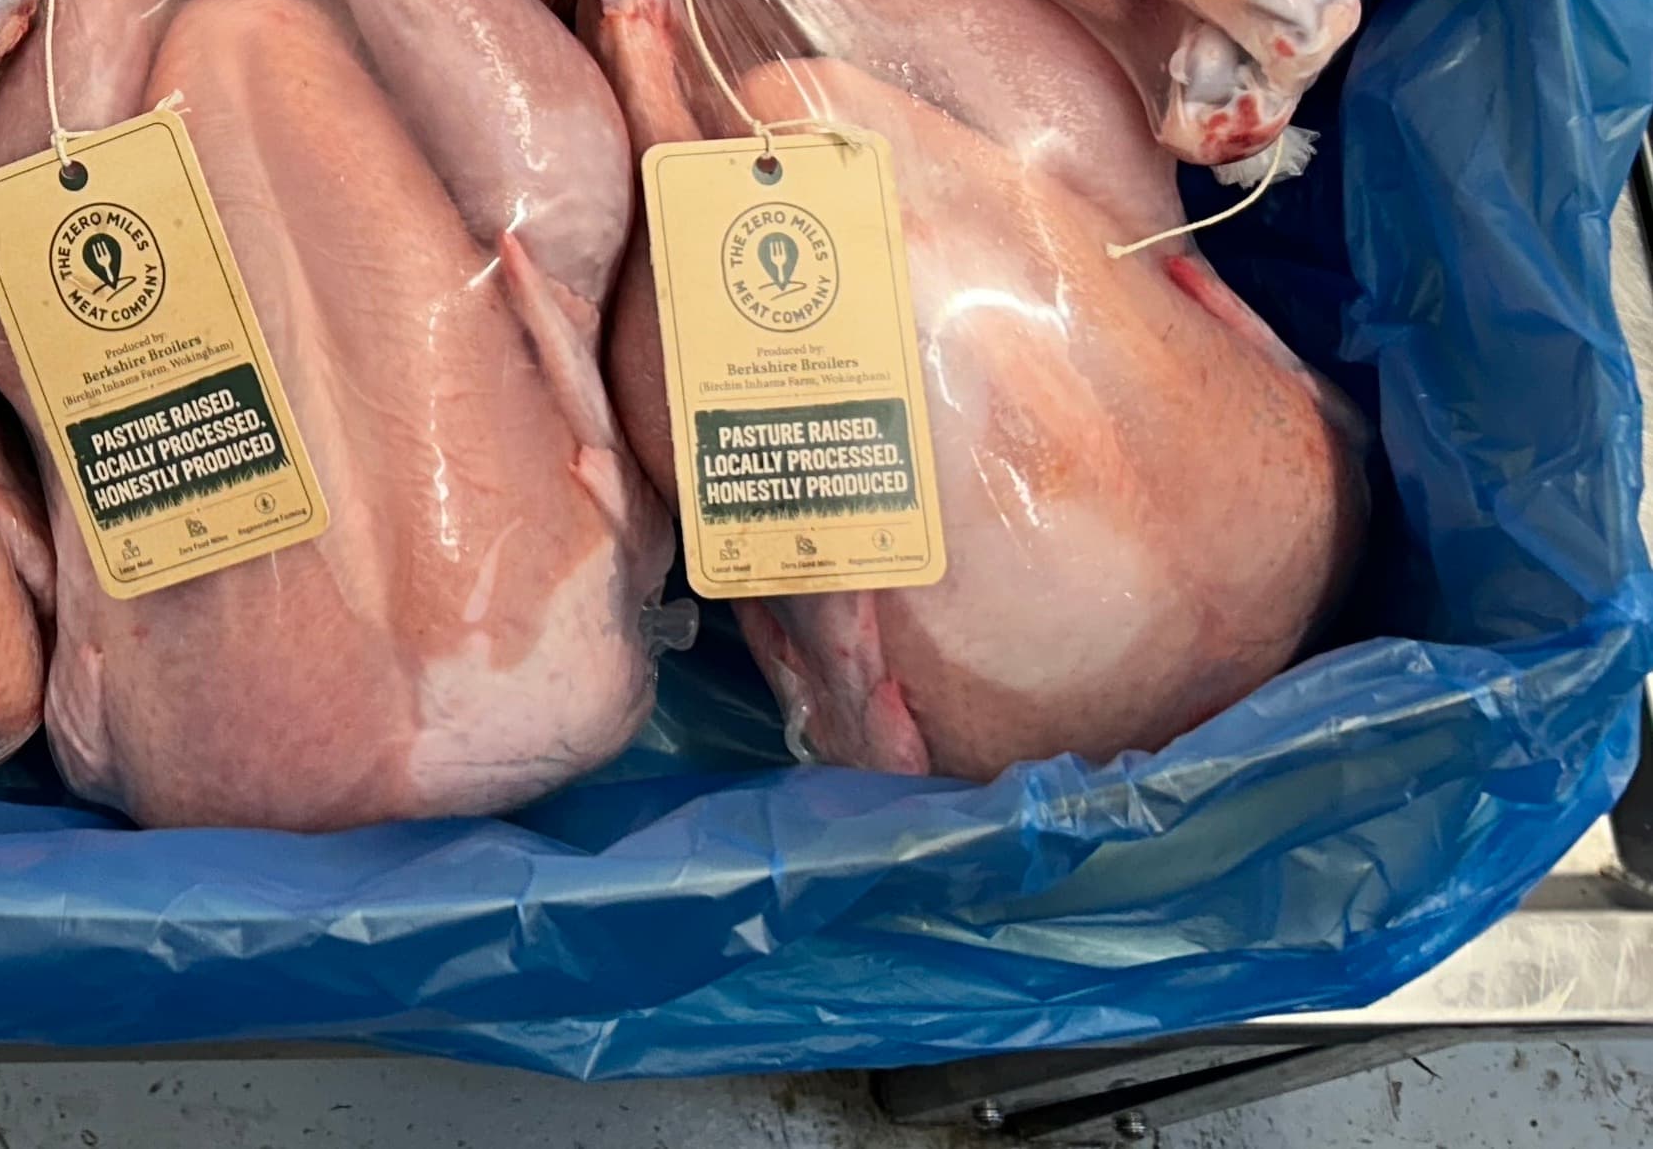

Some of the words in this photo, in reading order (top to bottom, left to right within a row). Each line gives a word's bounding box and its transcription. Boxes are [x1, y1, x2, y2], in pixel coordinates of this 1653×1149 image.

[62, 211, 102, 245] ZERO
[106, 211, 149, 252] MILES
[729, 234, 747, 269] THE
[740, 210, 787, 236] ZERO
[790, 215, 829, 262] MILES
[58, 246, 73, 281] THE
[68, 289, 109, 322] MEAT
[111, 263, 158, 323] COMPANY
[732, 279, 771, 319] MEAT
[771, 275, 832, 324] COMPANY
[81, 356, 147, 386] Berkshire
[147, 335, 203, 362] Broilers
[104, 335, 152, 360] Produced
[725, 360, 798, 377] Berkshire
[800, 355, 859, 371] Broilers
[755, 344, 807, 357] Produced
[62, 388, 102, 410] (Birchin
[102, 374, 141, 394] Inhams
[169, 338, 235, 369] Wokingham)
[698, 380, 742, 395] (Birchin
[744, 378, 786, 390] Inhams
[820, 369, 891, 385] Wokingham)
[91, 411, 171, 456] PASTURE
[169, 389, 241, 429] RAISED.
[718, 422, 805, 449] PASTURE
[807, 417, 883, 443] RAISED.
[84, 443, 157, 486] LOCALLY
[157, 409, 267, 461] PROCESSED.
[704, 450, 783, 478] LOCALLY
[786, 443, 904, 472] PROCESSED.
[93, 463, 180, 511] HONESTLY
[180, 432, 276, 482] PRODUCED
[707, 476, 802, 505] HONESTLY
[806, 470, 908, 499] PRODUCED
